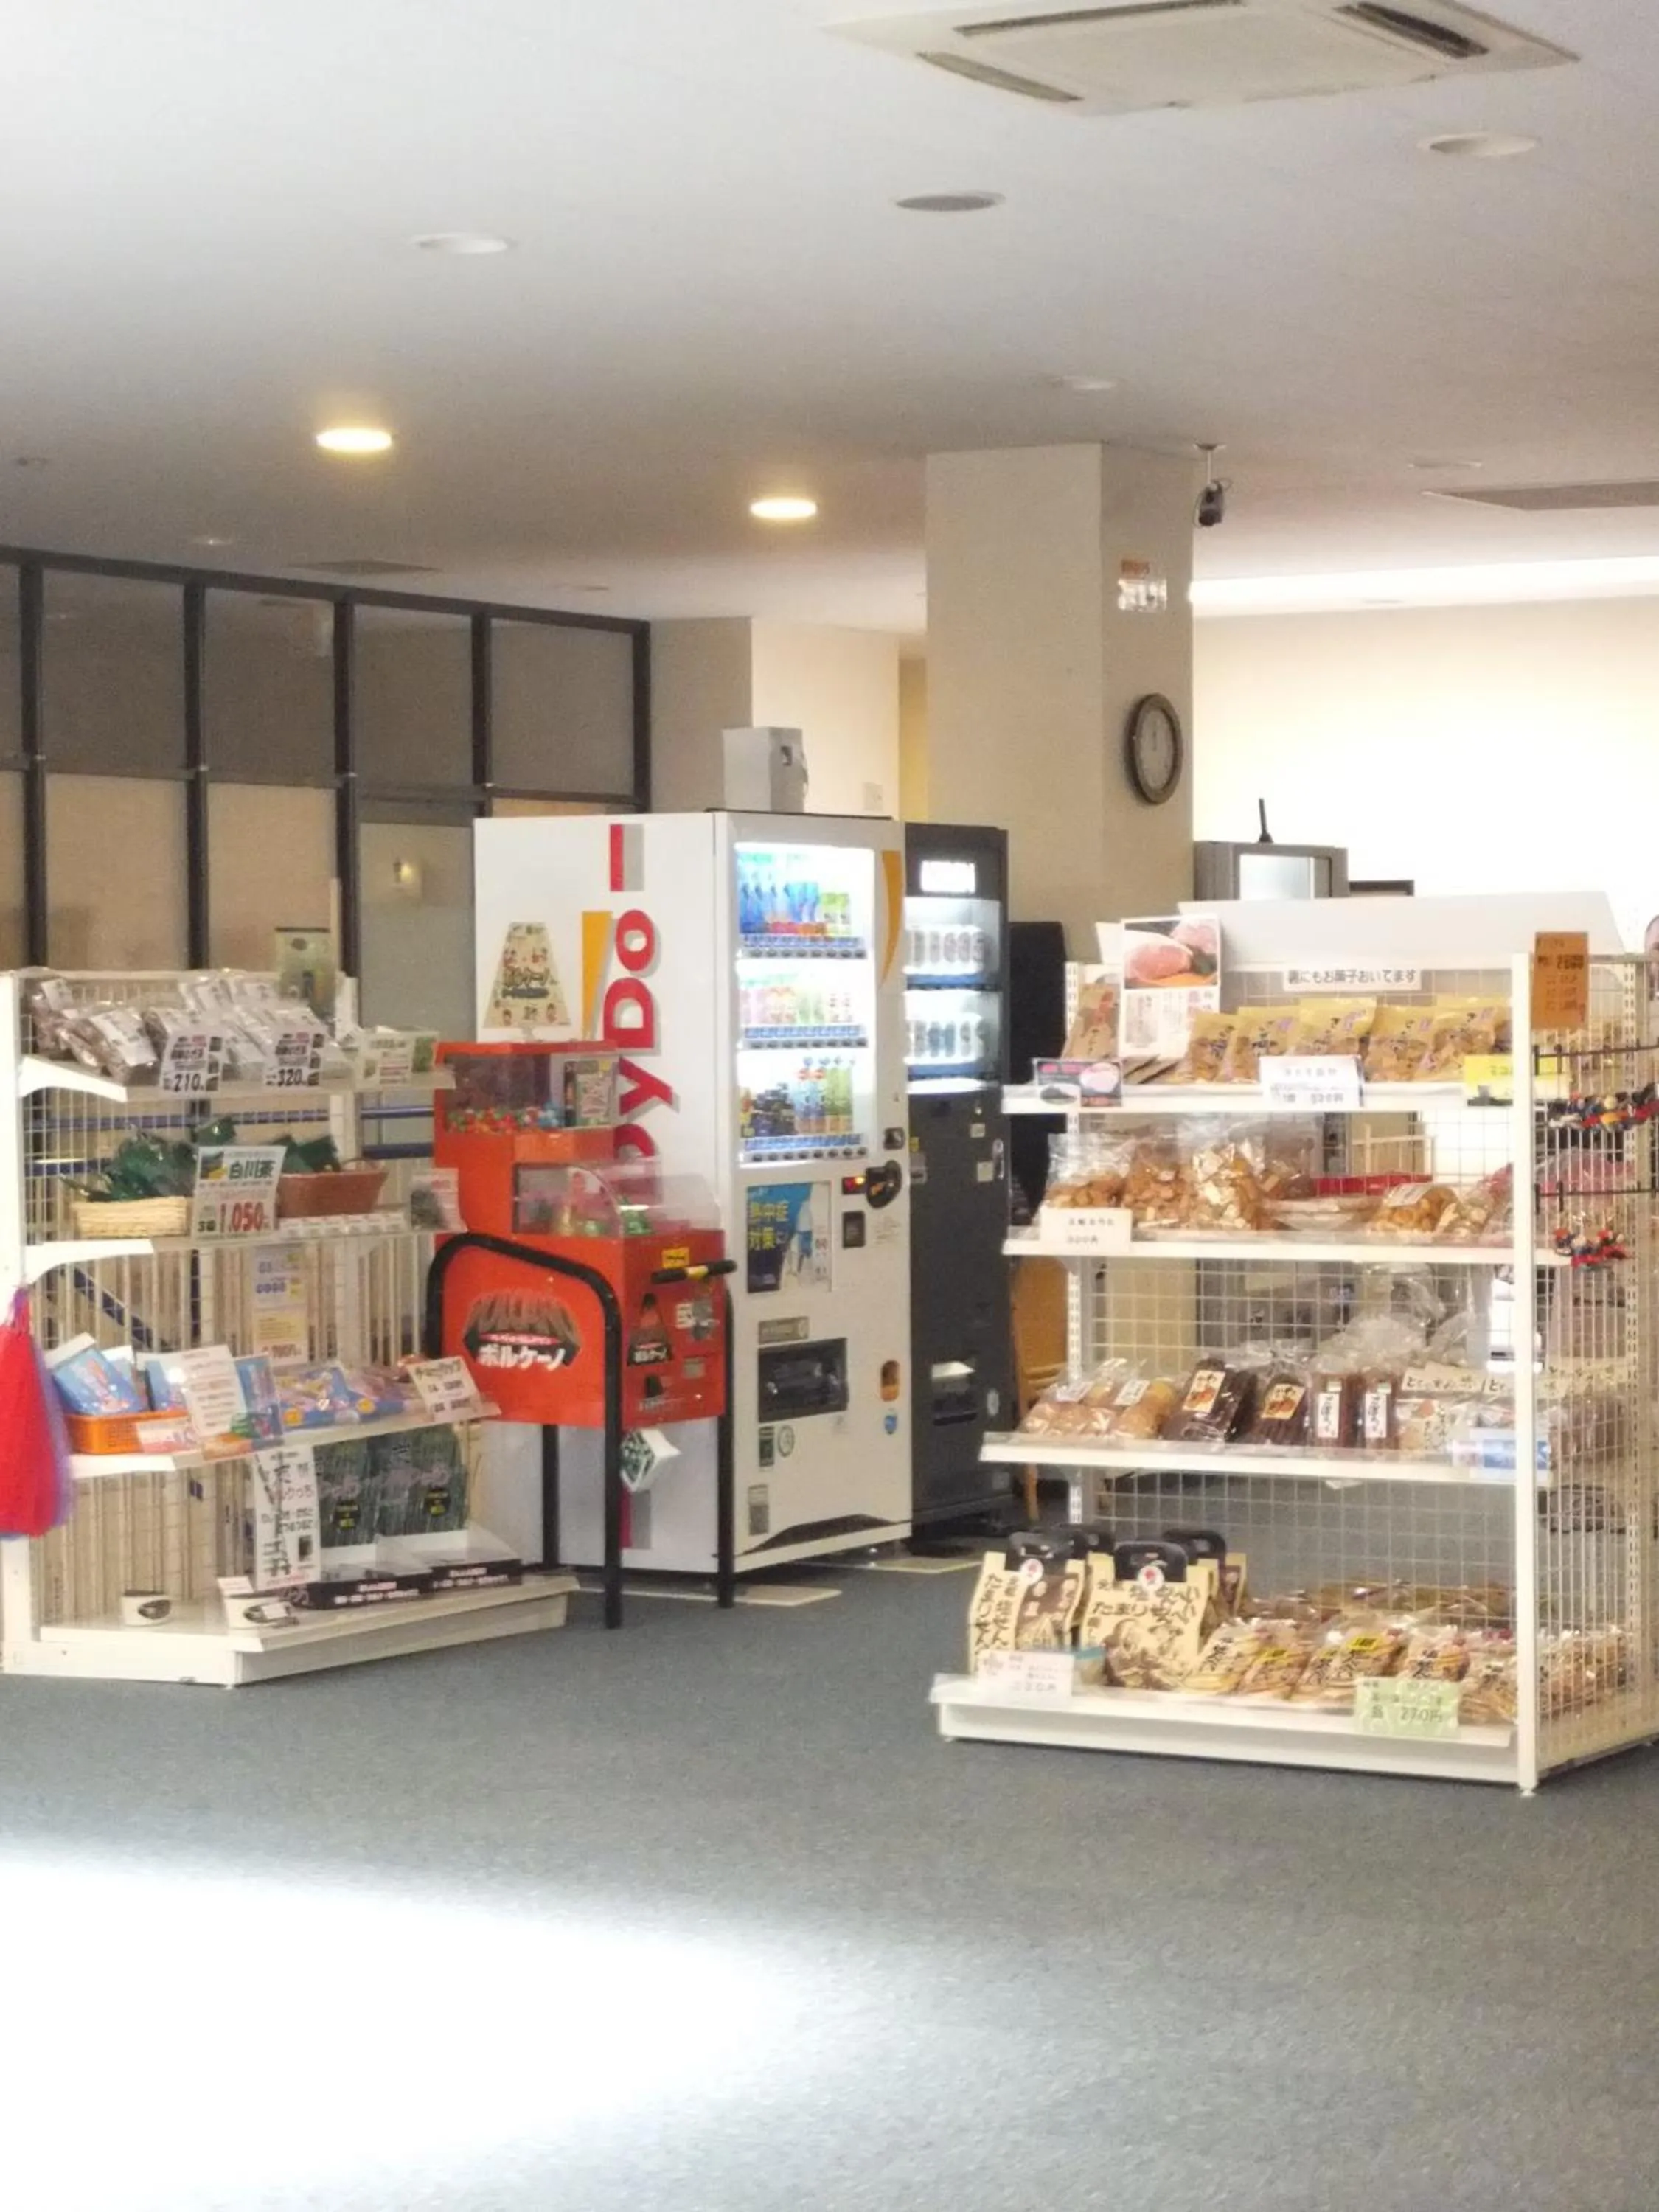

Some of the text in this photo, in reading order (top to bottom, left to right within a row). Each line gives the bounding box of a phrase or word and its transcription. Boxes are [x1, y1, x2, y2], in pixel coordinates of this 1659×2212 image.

[477, 1343, 566, 1371] ボルケーノ
